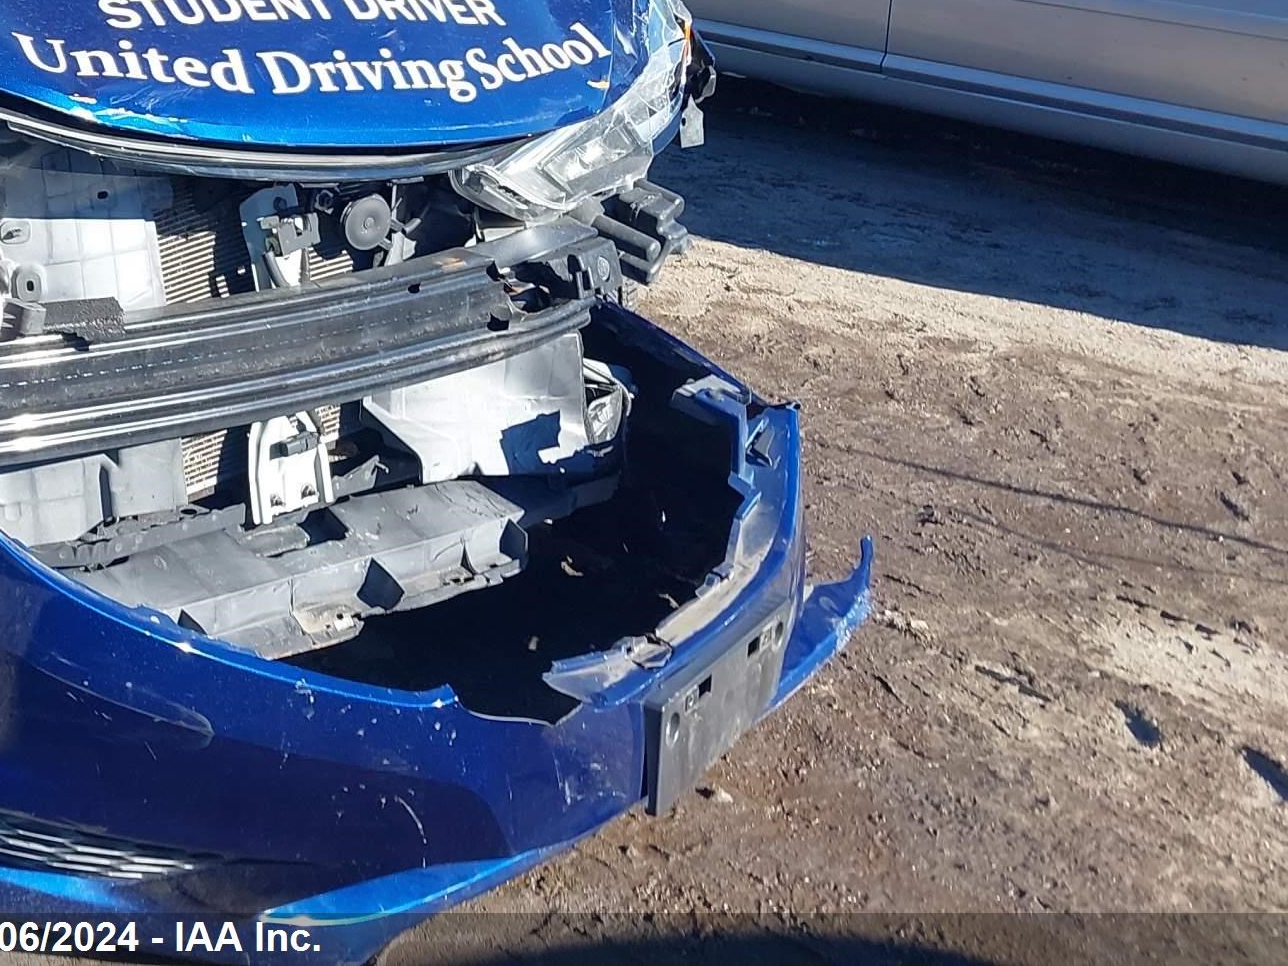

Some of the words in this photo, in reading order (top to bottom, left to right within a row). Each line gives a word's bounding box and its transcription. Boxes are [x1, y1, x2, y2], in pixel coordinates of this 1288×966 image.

[11, 31, 255, 94] United
[256, 47, 478, 103] Driving
[465, 21, 611, 91] School
